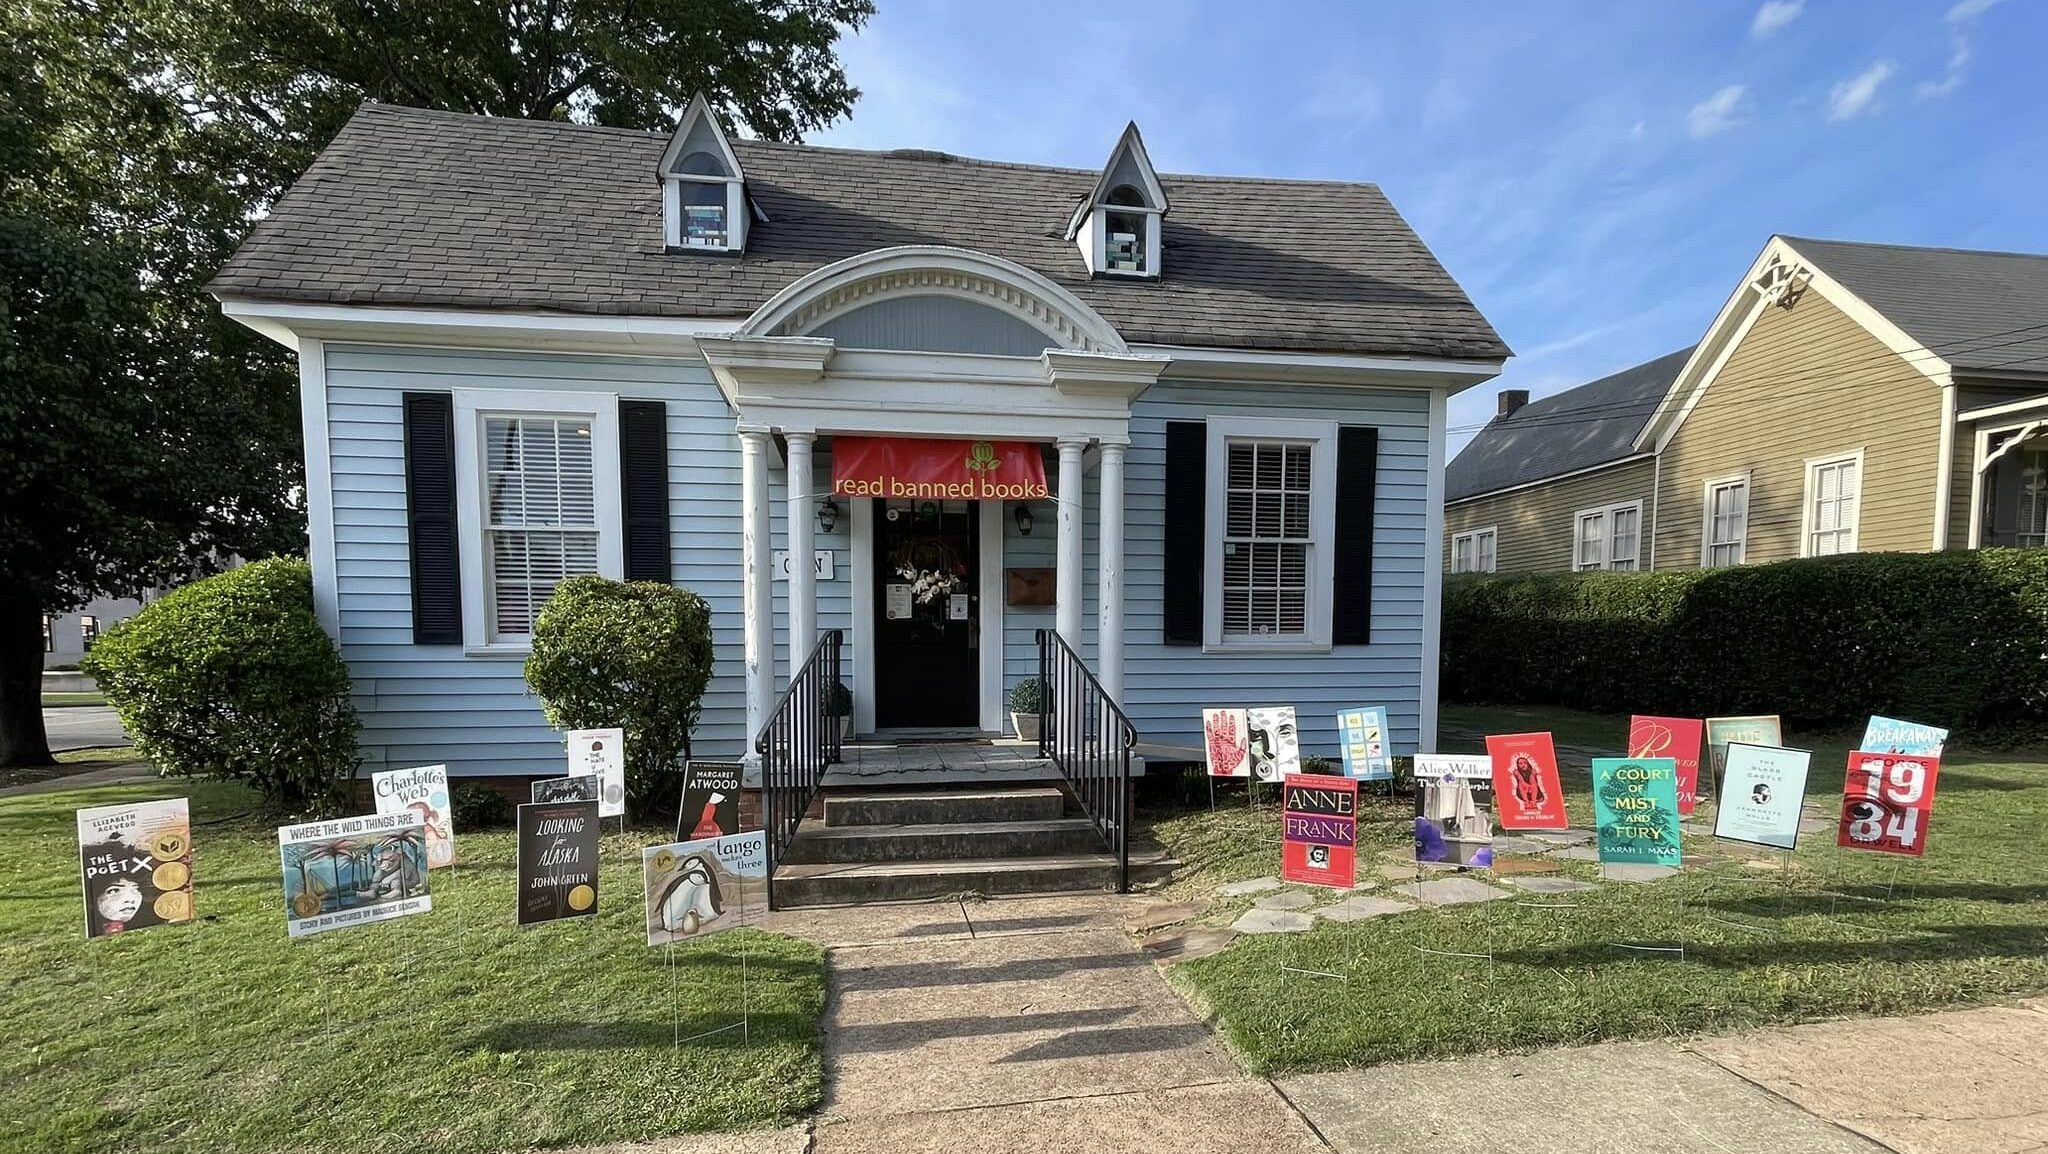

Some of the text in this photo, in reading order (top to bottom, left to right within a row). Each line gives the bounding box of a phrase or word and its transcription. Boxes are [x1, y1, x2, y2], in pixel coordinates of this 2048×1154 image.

[835, 476, 1047, 498] read banned books
[1417, 762, 1490, 775] Alice Walker
[1600, 768, 1672, 781] A COURT
[376, 769, 445, 798] Charlotte's
[689, 779, 738, 790] ATWOOD
[1628, 784, 1644, 793] OF
[1860, 759, 1926, 803] 19
[397, 785, 429, 802] Web
[1287, 789, 1353, 814] ANNE
[1615, 797, 1659, 810] MIST
[93, 814, 136, 828] ELIZABETH
[536, 816, 584, 836] LOOKING
[1625, 814, 1650, 823] AND
[1849, 802, 1920, 846] 84
[98, 822, 136, 833] ACEVEDO
[290, 813, 414, 841] WHERE THE WILD THINGS ARE
[1286, 817, 1352, 841] FRANK
[1615, 826, 1663, 840] FURY
[537, 846, 580, 867] ALASKA
[1603, 845, 1636, 854] SARAH
[1648, 846, 1678, 855] MAAS
[89, 853, 113, 866] THE
[737, 860, 763, 869] three
[87, 856, 153, 879] POET X
[531, 872, 588, 889] JOHN GREEN
